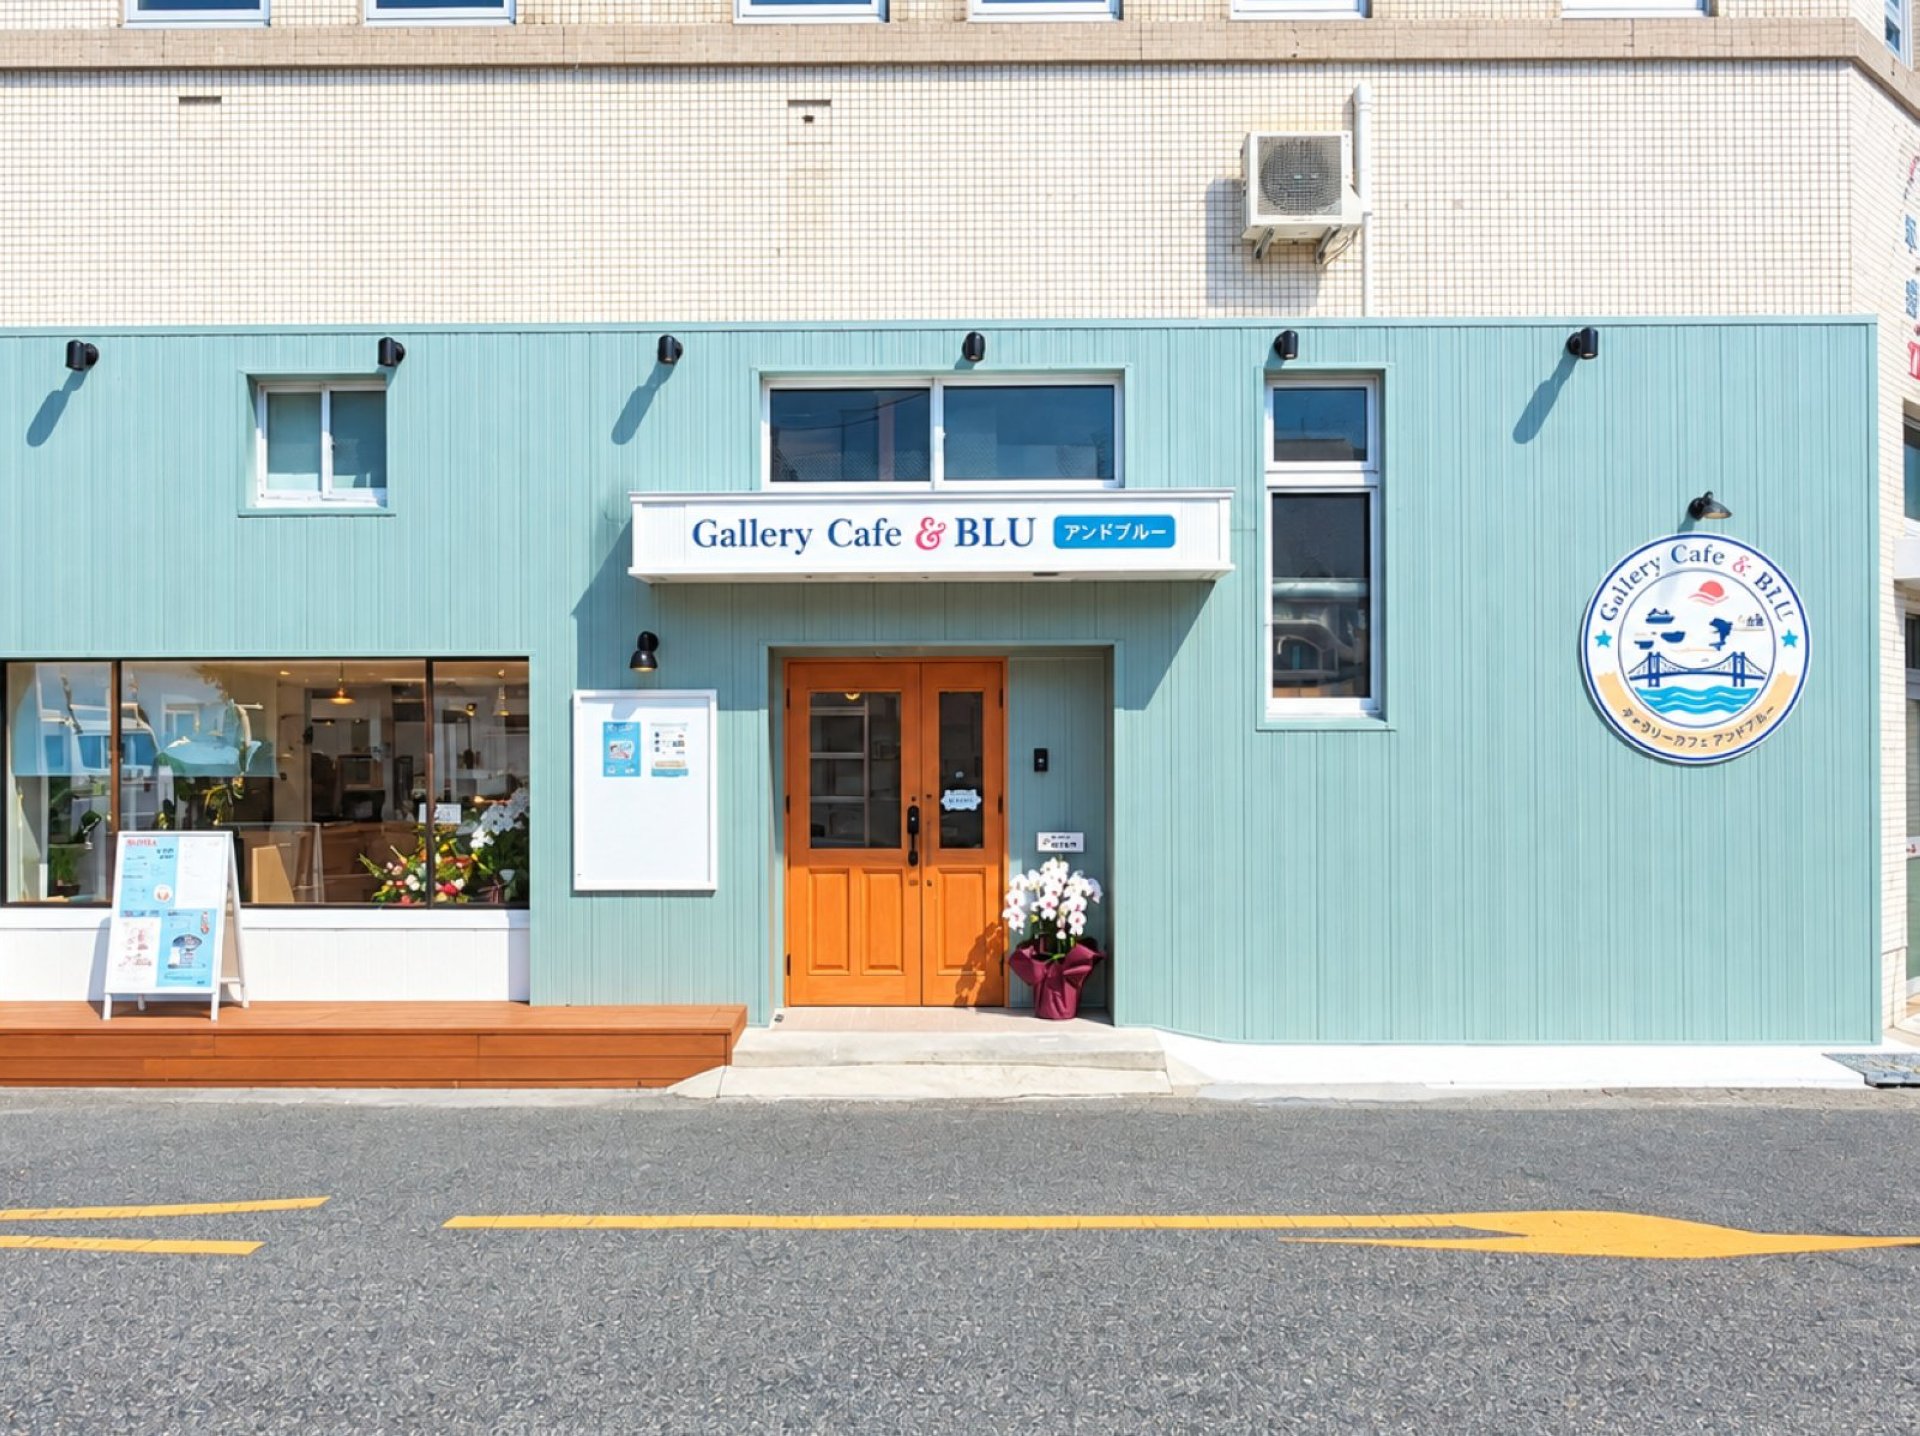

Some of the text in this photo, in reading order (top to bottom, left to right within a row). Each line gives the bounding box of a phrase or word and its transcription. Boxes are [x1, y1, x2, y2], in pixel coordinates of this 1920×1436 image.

[693, 517, 1037, 555] Gallery Cafe & BLU
[1064, 523, 1166, 541] アンドブルー
[1600, 556, 1660, 621] Gallery
[1671, 544, 1725, 565] Cafe
